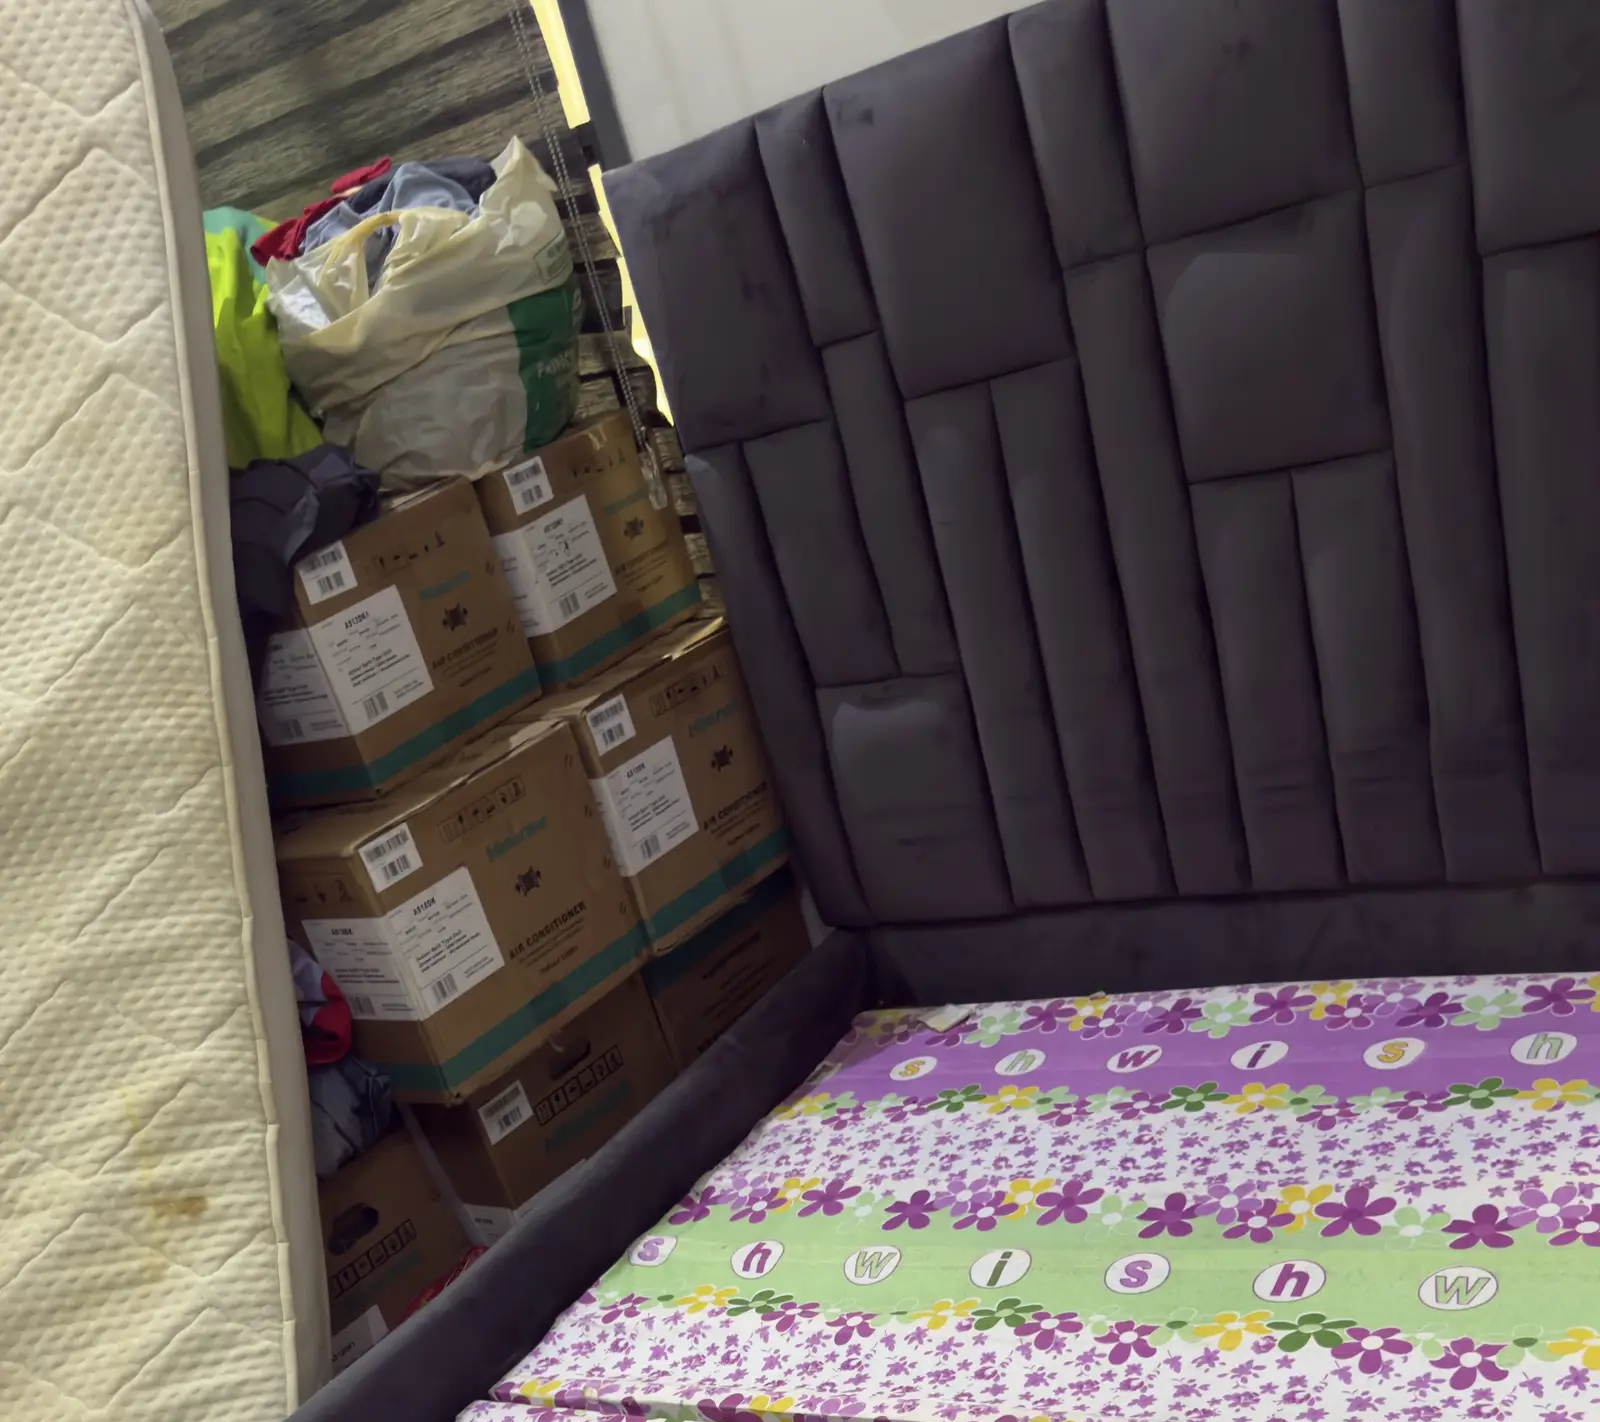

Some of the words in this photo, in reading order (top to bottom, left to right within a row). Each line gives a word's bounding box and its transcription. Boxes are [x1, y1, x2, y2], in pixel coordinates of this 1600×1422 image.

[508, 942, 526, 960] AIR
[526, 901, 587, 947] CONDITIONER
[1005, 1050, 1036, 1072] h
[1526, 1033, 1564, 1059] h
[742, 1242, 772, 1273] h
[1269, 1263, 1309, 1297] h
